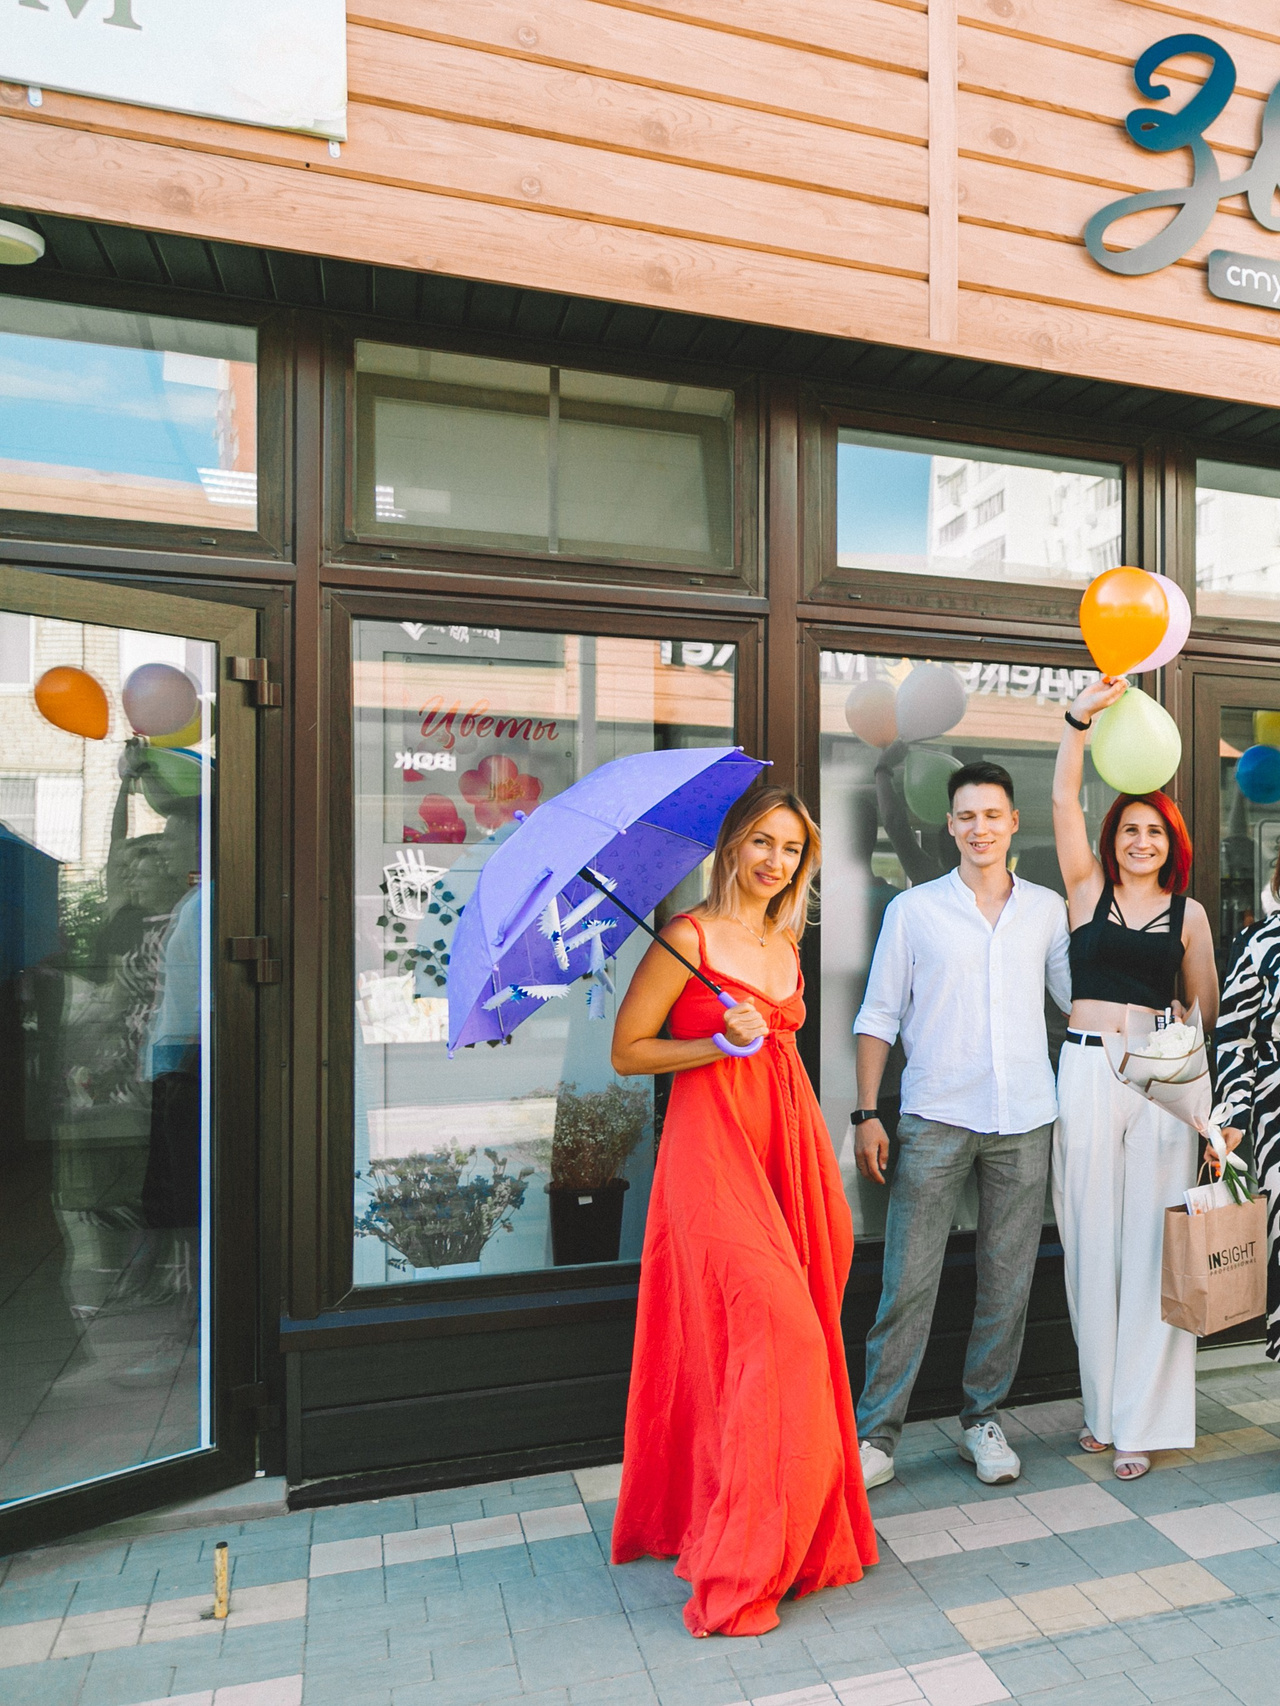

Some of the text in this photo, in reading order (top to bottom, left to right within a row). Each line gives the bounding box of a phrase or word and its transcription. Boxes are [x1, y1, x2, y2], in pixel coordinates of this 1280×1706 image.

[418, 694, 560, 749] Цветы
[1208, 1241, 1256, 1270] INSIGHT
[1209, 1257, 1257, 1276] PROFESSIONAL
